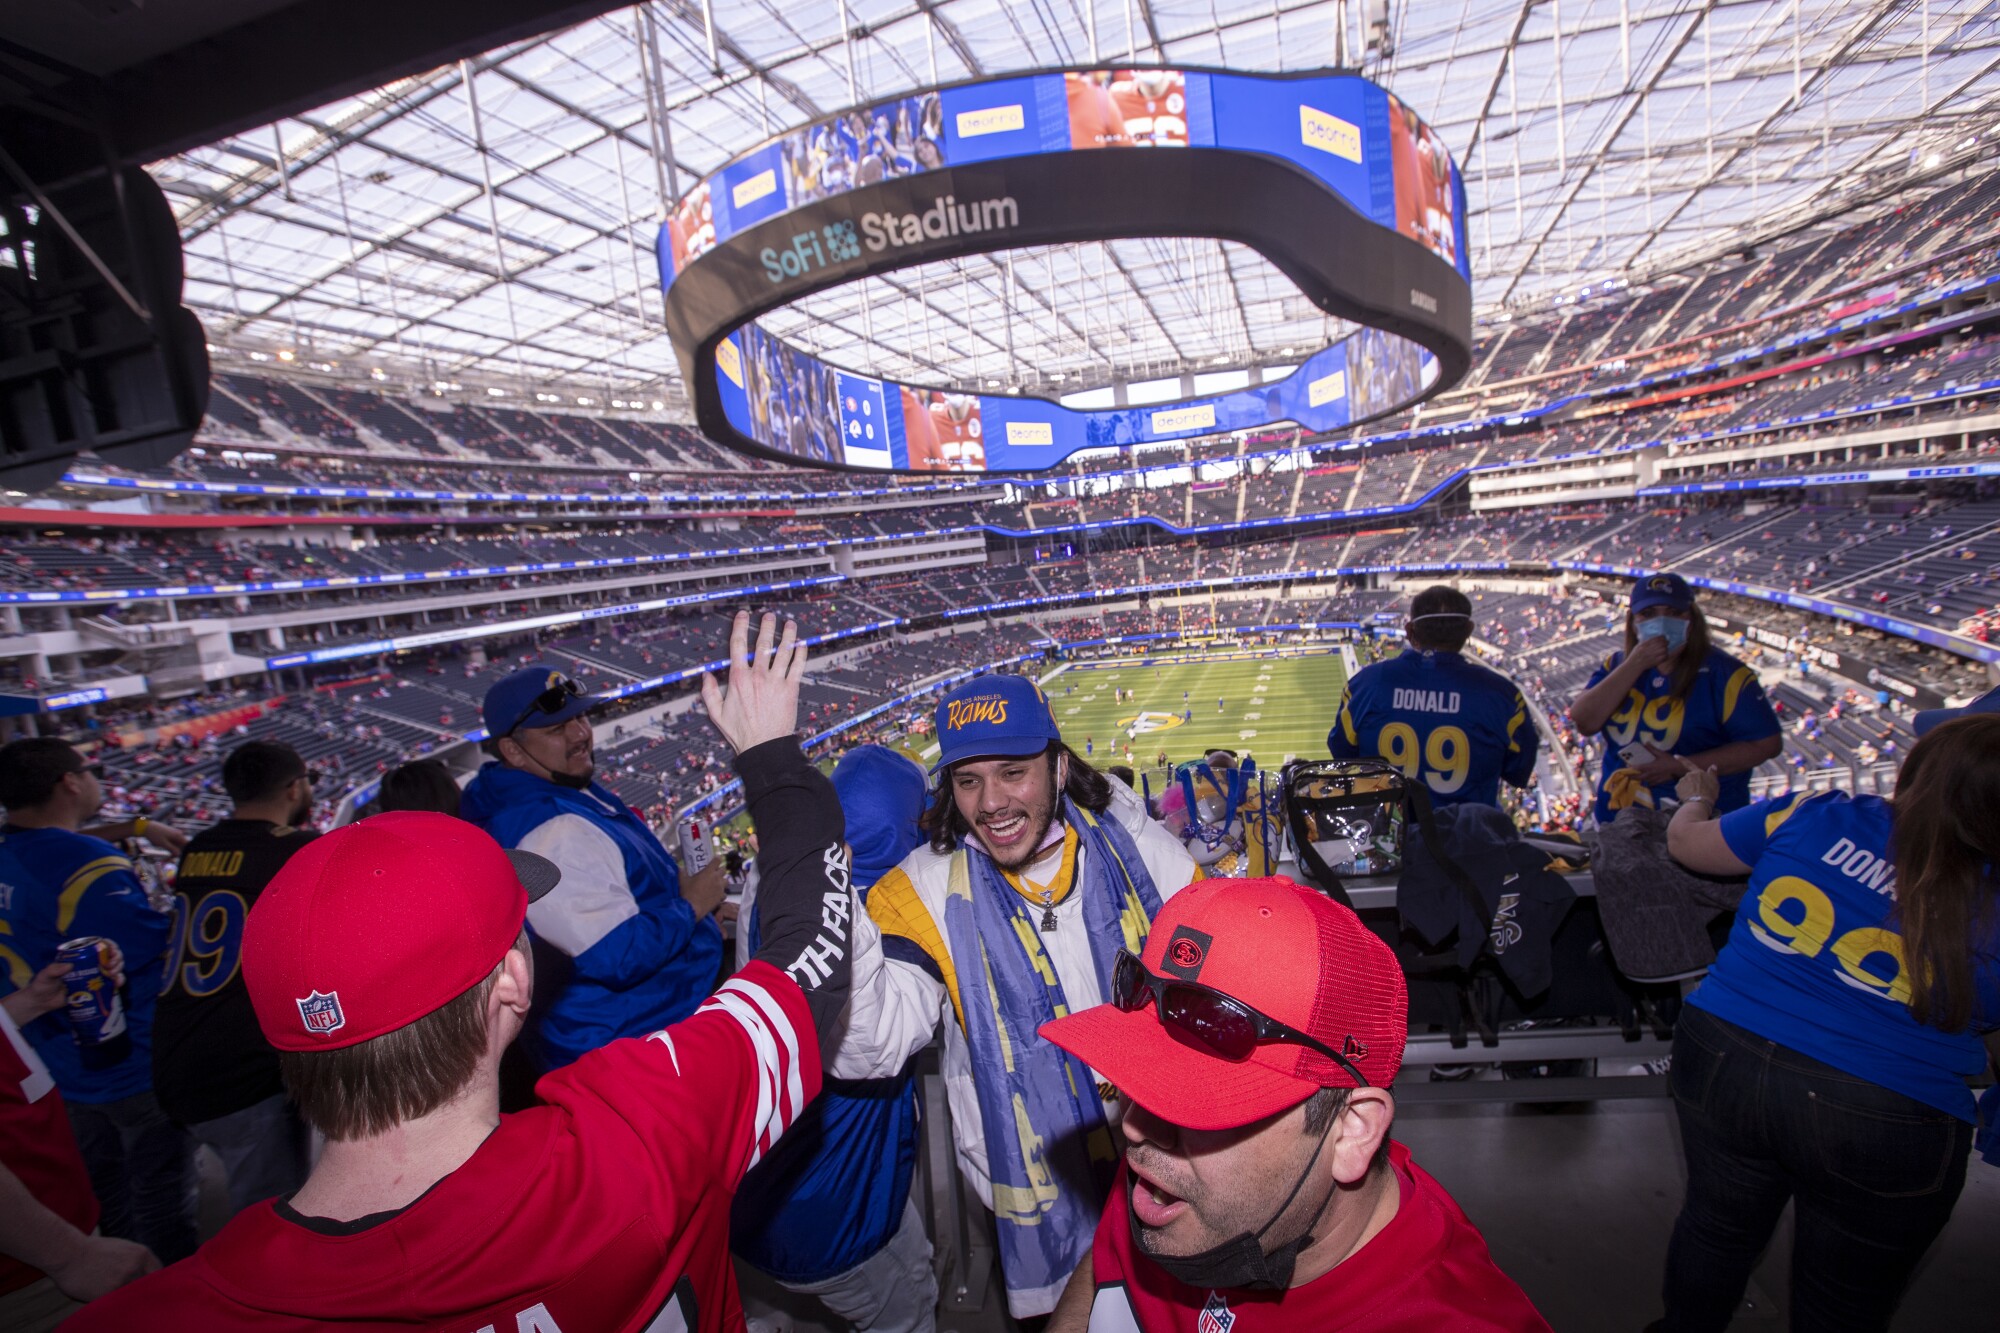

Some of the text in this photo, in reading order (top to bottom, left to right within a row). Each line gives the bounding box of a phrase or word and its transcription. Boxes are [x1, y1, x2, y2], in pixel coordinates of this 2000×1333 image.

[760, 195, 1019, 283] SoFi Stadium
[947, 699, 1009, 731] Rams
[973, 694, 1002, 702] ANGELES
[1393, 688, 1460, 714] DONALD
[1607, 690, 1685, 751] 99
[1378, 722, 1470, 794] 99
[694, 843, 706, 871] TRA
[1821, 837, 1897, 902] DONA
[821, 842, 850, 942] FACE
[784, 934, 845, 991] TH
[308, 1010, 337, 1028] NFL
